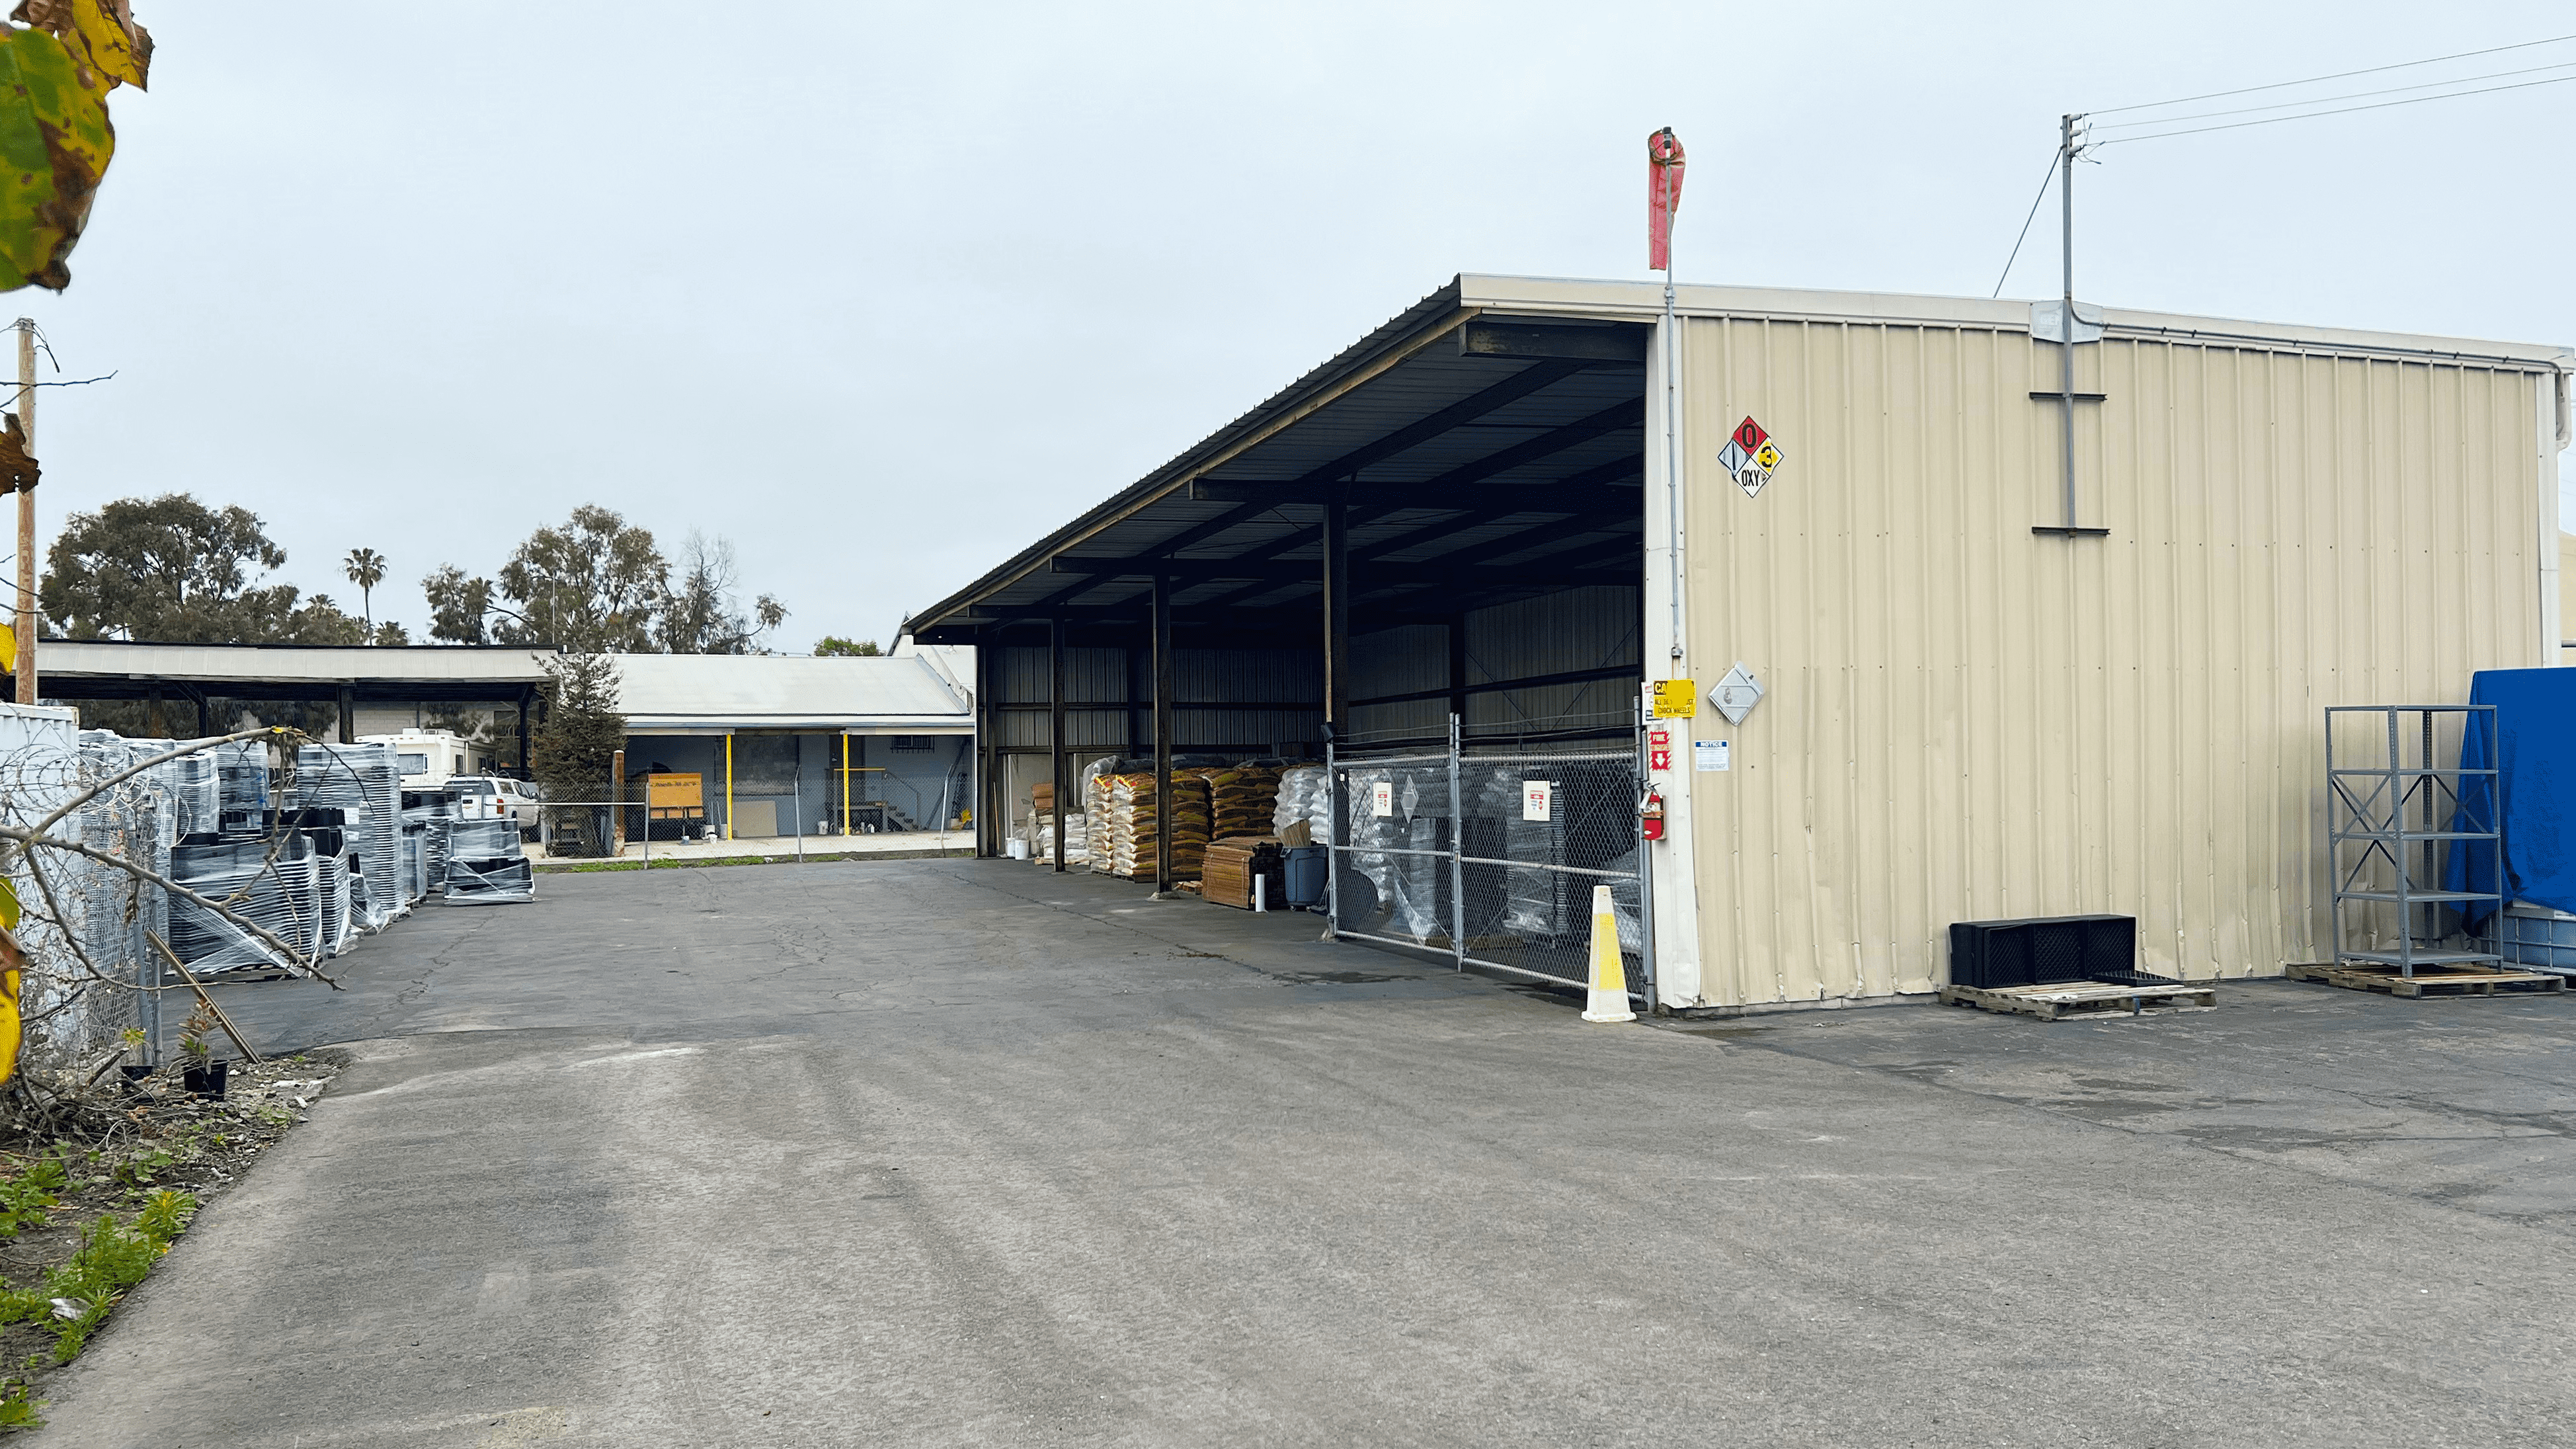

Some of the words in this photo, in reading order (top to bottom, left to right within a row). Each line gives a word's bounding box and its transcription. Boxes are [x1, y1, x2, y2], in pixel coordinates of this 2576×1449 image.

[1742, 424, 1757, 448] 0
[1761, 446, 1772, 468] 3
[1741, 470, 1760, 487] OXY
